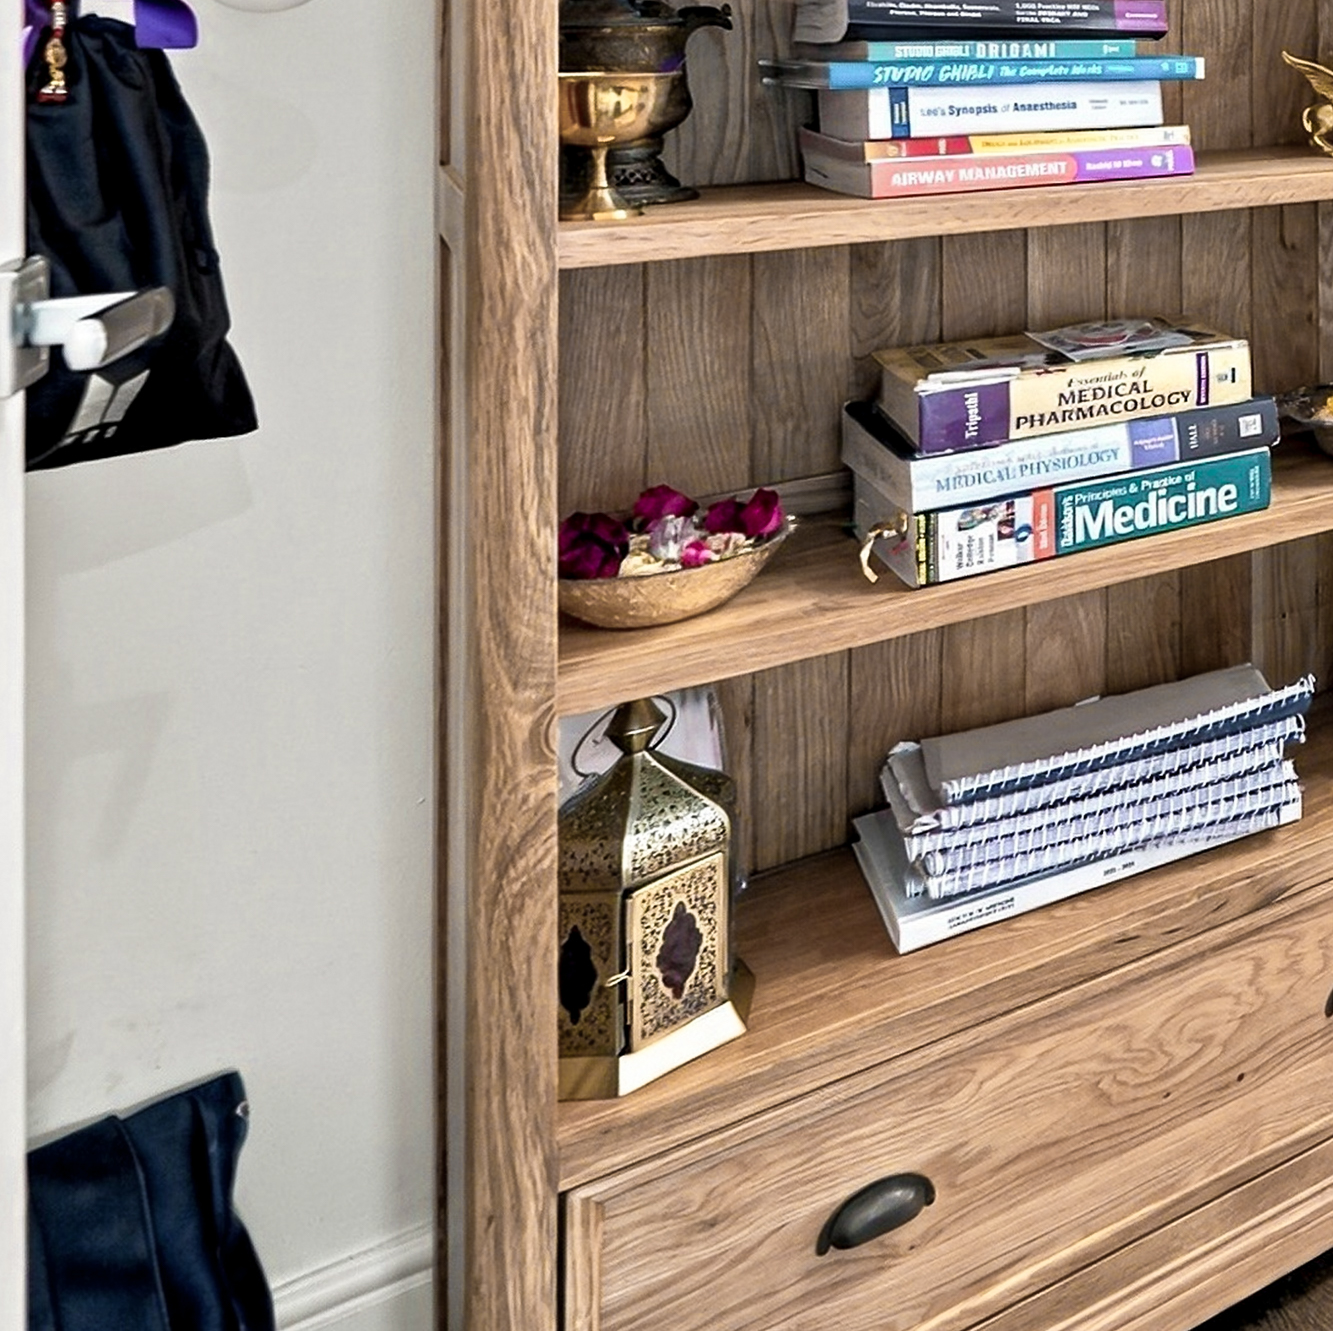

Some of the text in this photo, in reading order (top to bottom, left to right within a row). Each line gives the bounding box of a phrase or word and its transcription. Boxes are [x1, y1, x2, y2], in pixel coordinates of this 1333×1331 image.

[895, 43, 1056, 58] STUDIO GHIBLI ORIGAMI
[873, 65, 934, 83] STUDIO
[938, 64, 995, 82] GHIBLI
[1000, 67, 1017, 77] The
[1019, 66, 1070, 77] Complete
[1071, 66, 1102, 76] Works
[948, 105, 998, 116] Synopsis
[1001, 104, 1011, 113] of
[1012, 100, 1077, 112] Anaesthesia
[892, 162, 1068, 186] AIRWAY MANAGEMENT
[1067, 366, 1146, 387] Essentials of
[1058, 380, 1153, 406] MEDICAL
[964, 392, 981, 440] Tripathi
[1015, 390, 1192, 430] PHARMACOLOGY
[1189, 424, 1198, 449] HALL
[935, 465, 1017, 493] MEDICAL
[1019, 447, 1121, 481] PHYSIOLOGY
[1074, 470, 1195, 505] Principles & Practice of
[1074, 481, 1238, 545] Medicine
